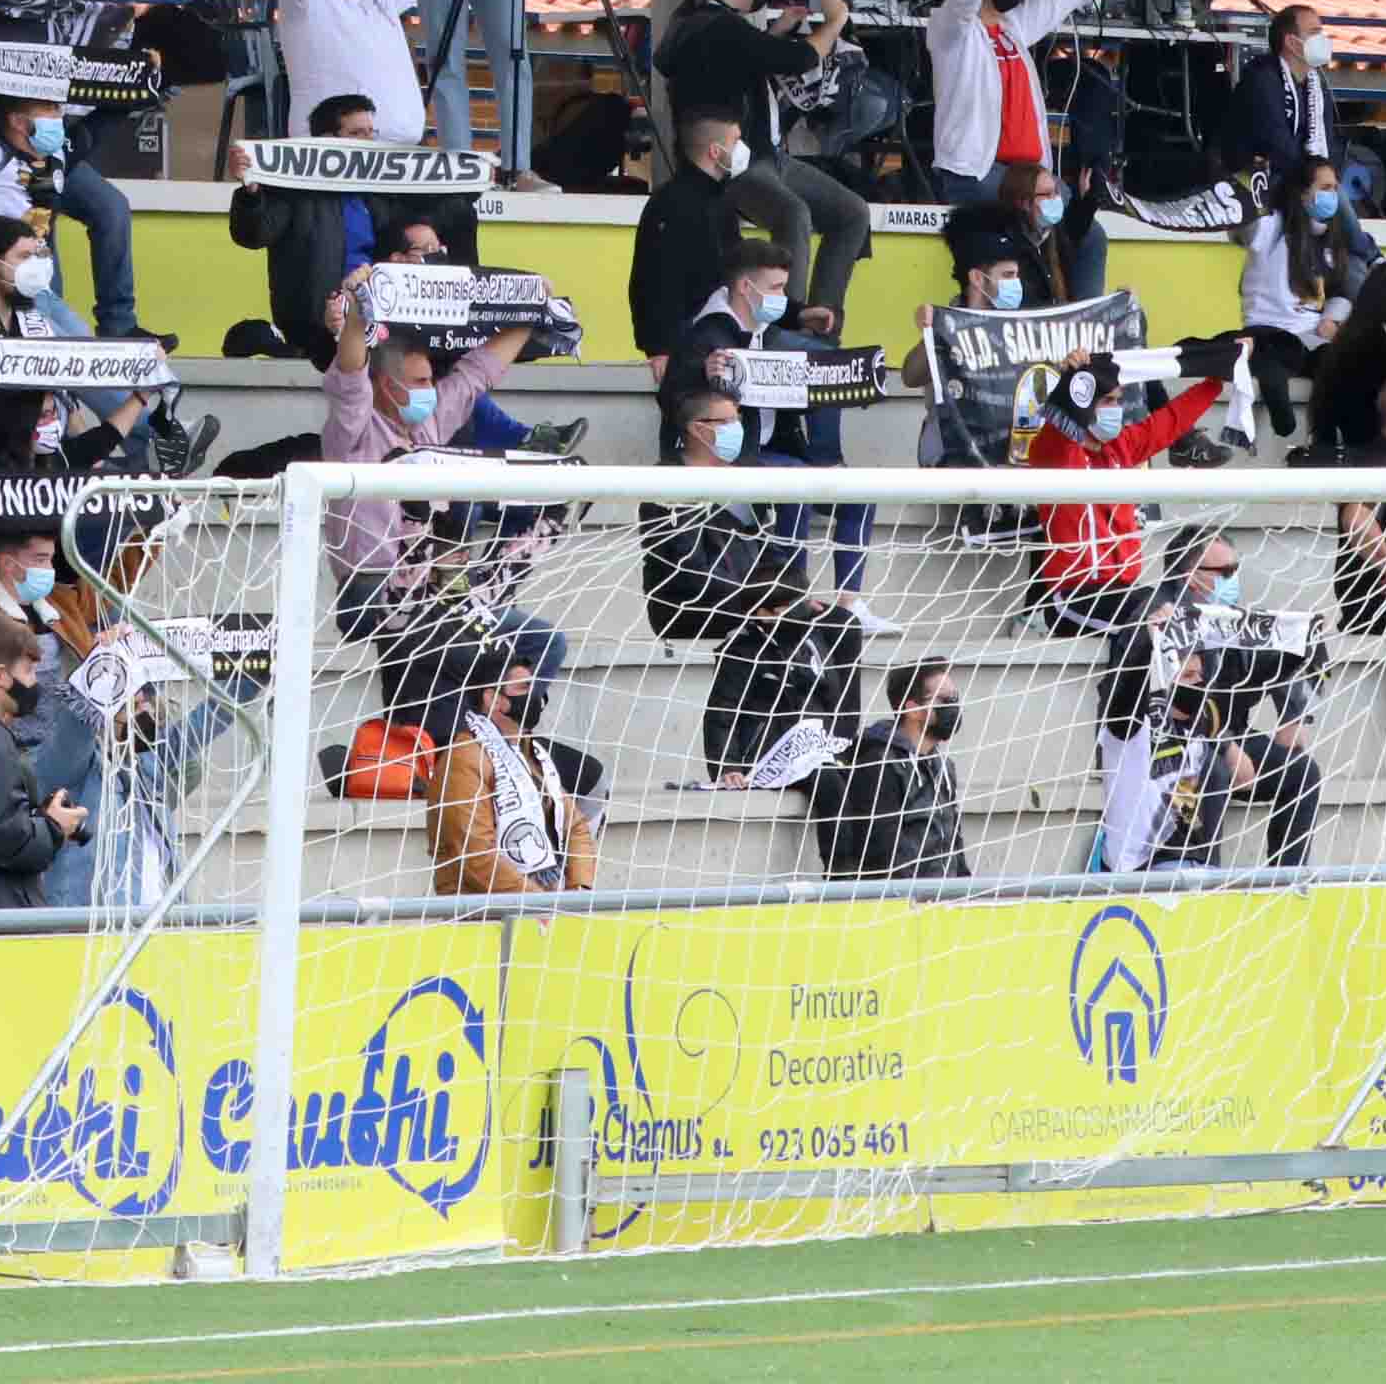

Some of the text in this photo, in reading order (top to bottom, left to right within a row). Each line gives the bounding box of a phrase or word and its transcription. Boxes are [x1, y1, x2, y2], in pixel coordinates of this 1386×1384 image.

[254, 144, 482, 182] UNIONISTAS
[87, 357, 159, 384] RODRIGO
[789, 983, 880, 1021] Pintura
[768, 1044, 904, 1087] Decorativa
[759, 1121, 910, 1161] 923 065 461
